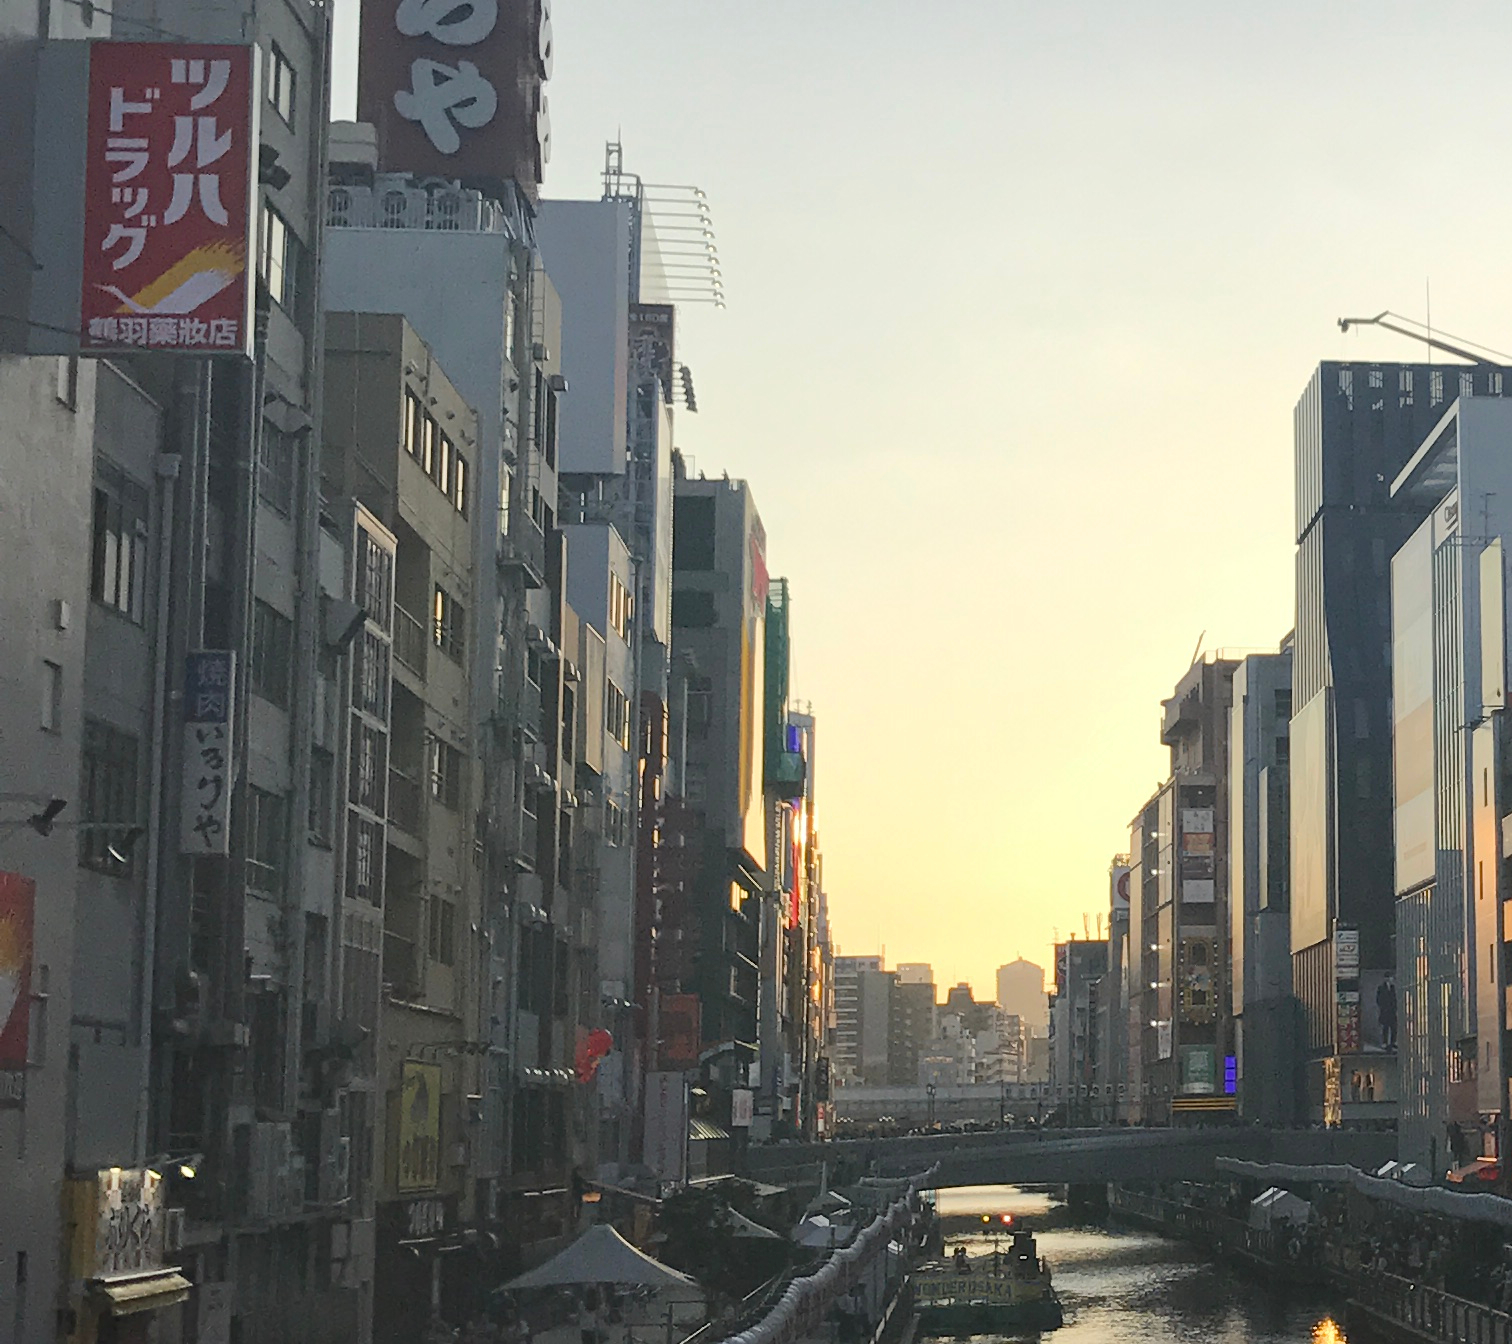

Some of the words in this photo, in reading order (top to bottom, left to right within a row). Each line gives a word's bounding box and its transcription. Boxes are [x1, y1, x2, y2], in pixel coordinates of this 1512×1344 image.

[101, 87, 160, 271] ドラッグ
[163, 59, 232, 226] ツルハ
